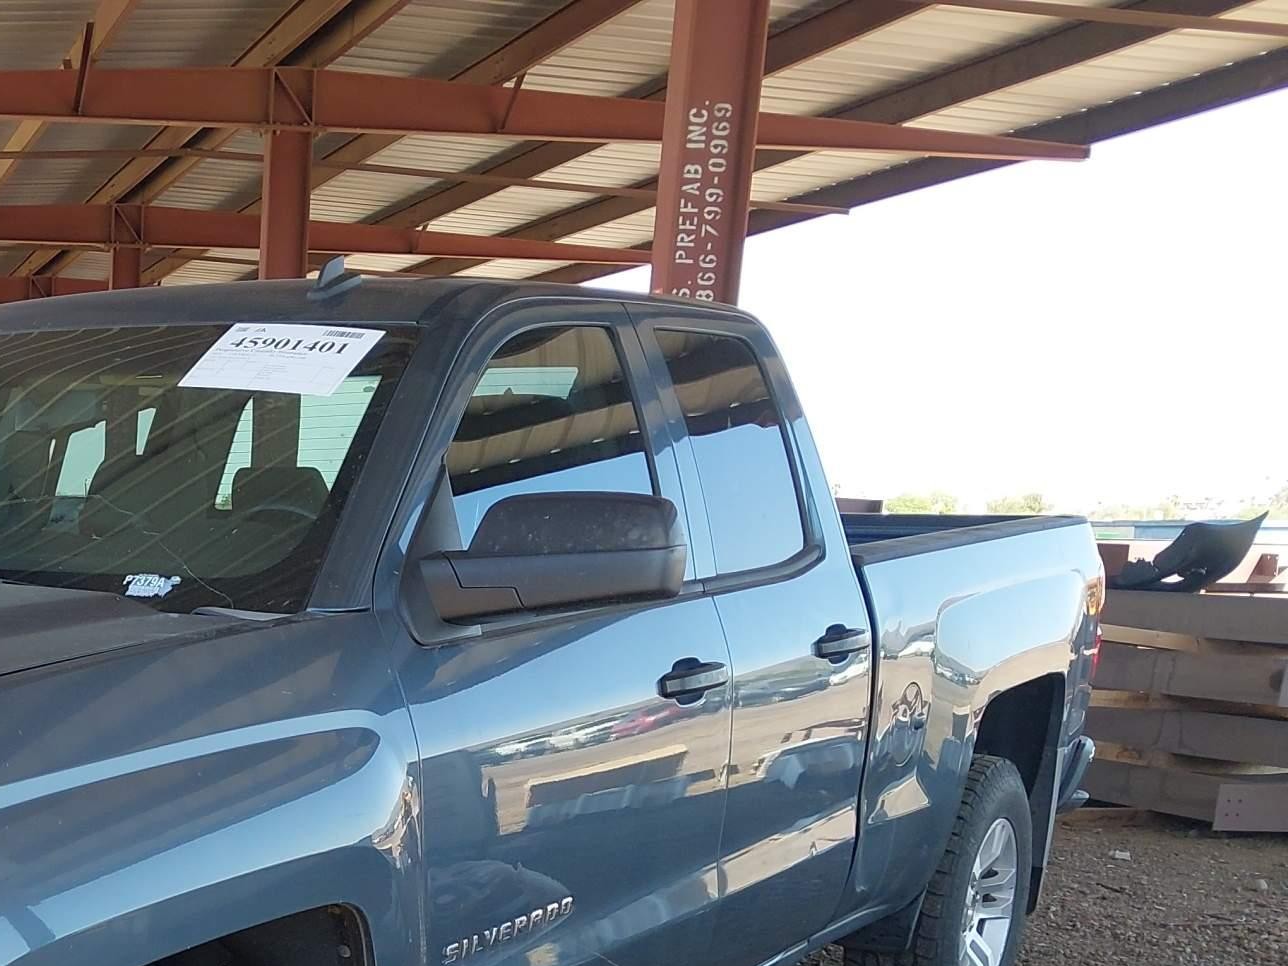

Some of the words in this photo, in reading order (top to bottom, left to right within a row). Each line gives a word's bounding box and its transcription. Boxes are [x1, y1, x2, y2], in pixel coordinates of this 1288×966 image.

[686, 100, 710, 149] INC.
[675, 164, 702, 264] PREFAB
[230, 336, 350, 355] 45901401
[442, 896, 574, 965] SILVERADO
